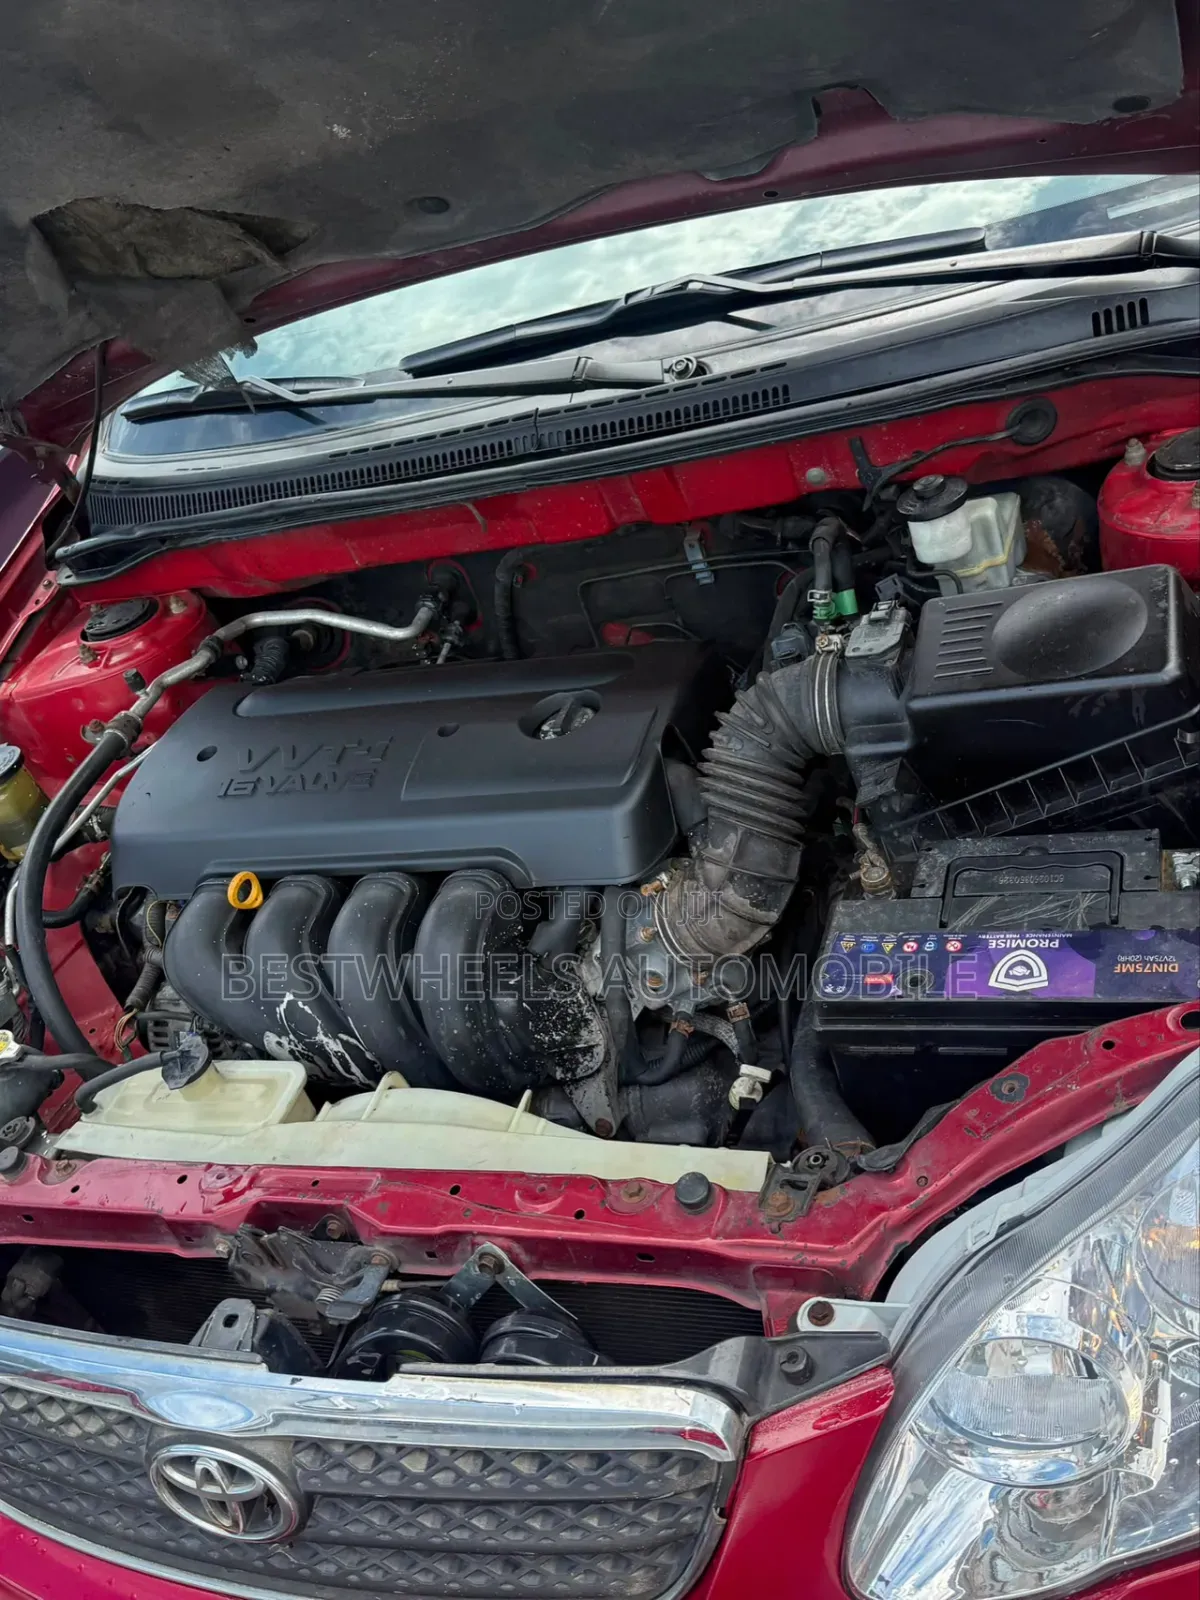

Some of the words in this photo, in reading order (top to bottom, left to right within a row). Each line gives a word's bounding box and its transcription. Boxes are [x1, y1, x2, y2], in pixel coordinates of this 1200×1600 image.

[217, 776, 261, 798] 16
[266, 768, 379, 796] VALVE
[988, 938, 1060, 949] PROMISE
[1117, 954, 1143, 962] (20HR)
[1113, 963, 1179, 973] DIN75MF
